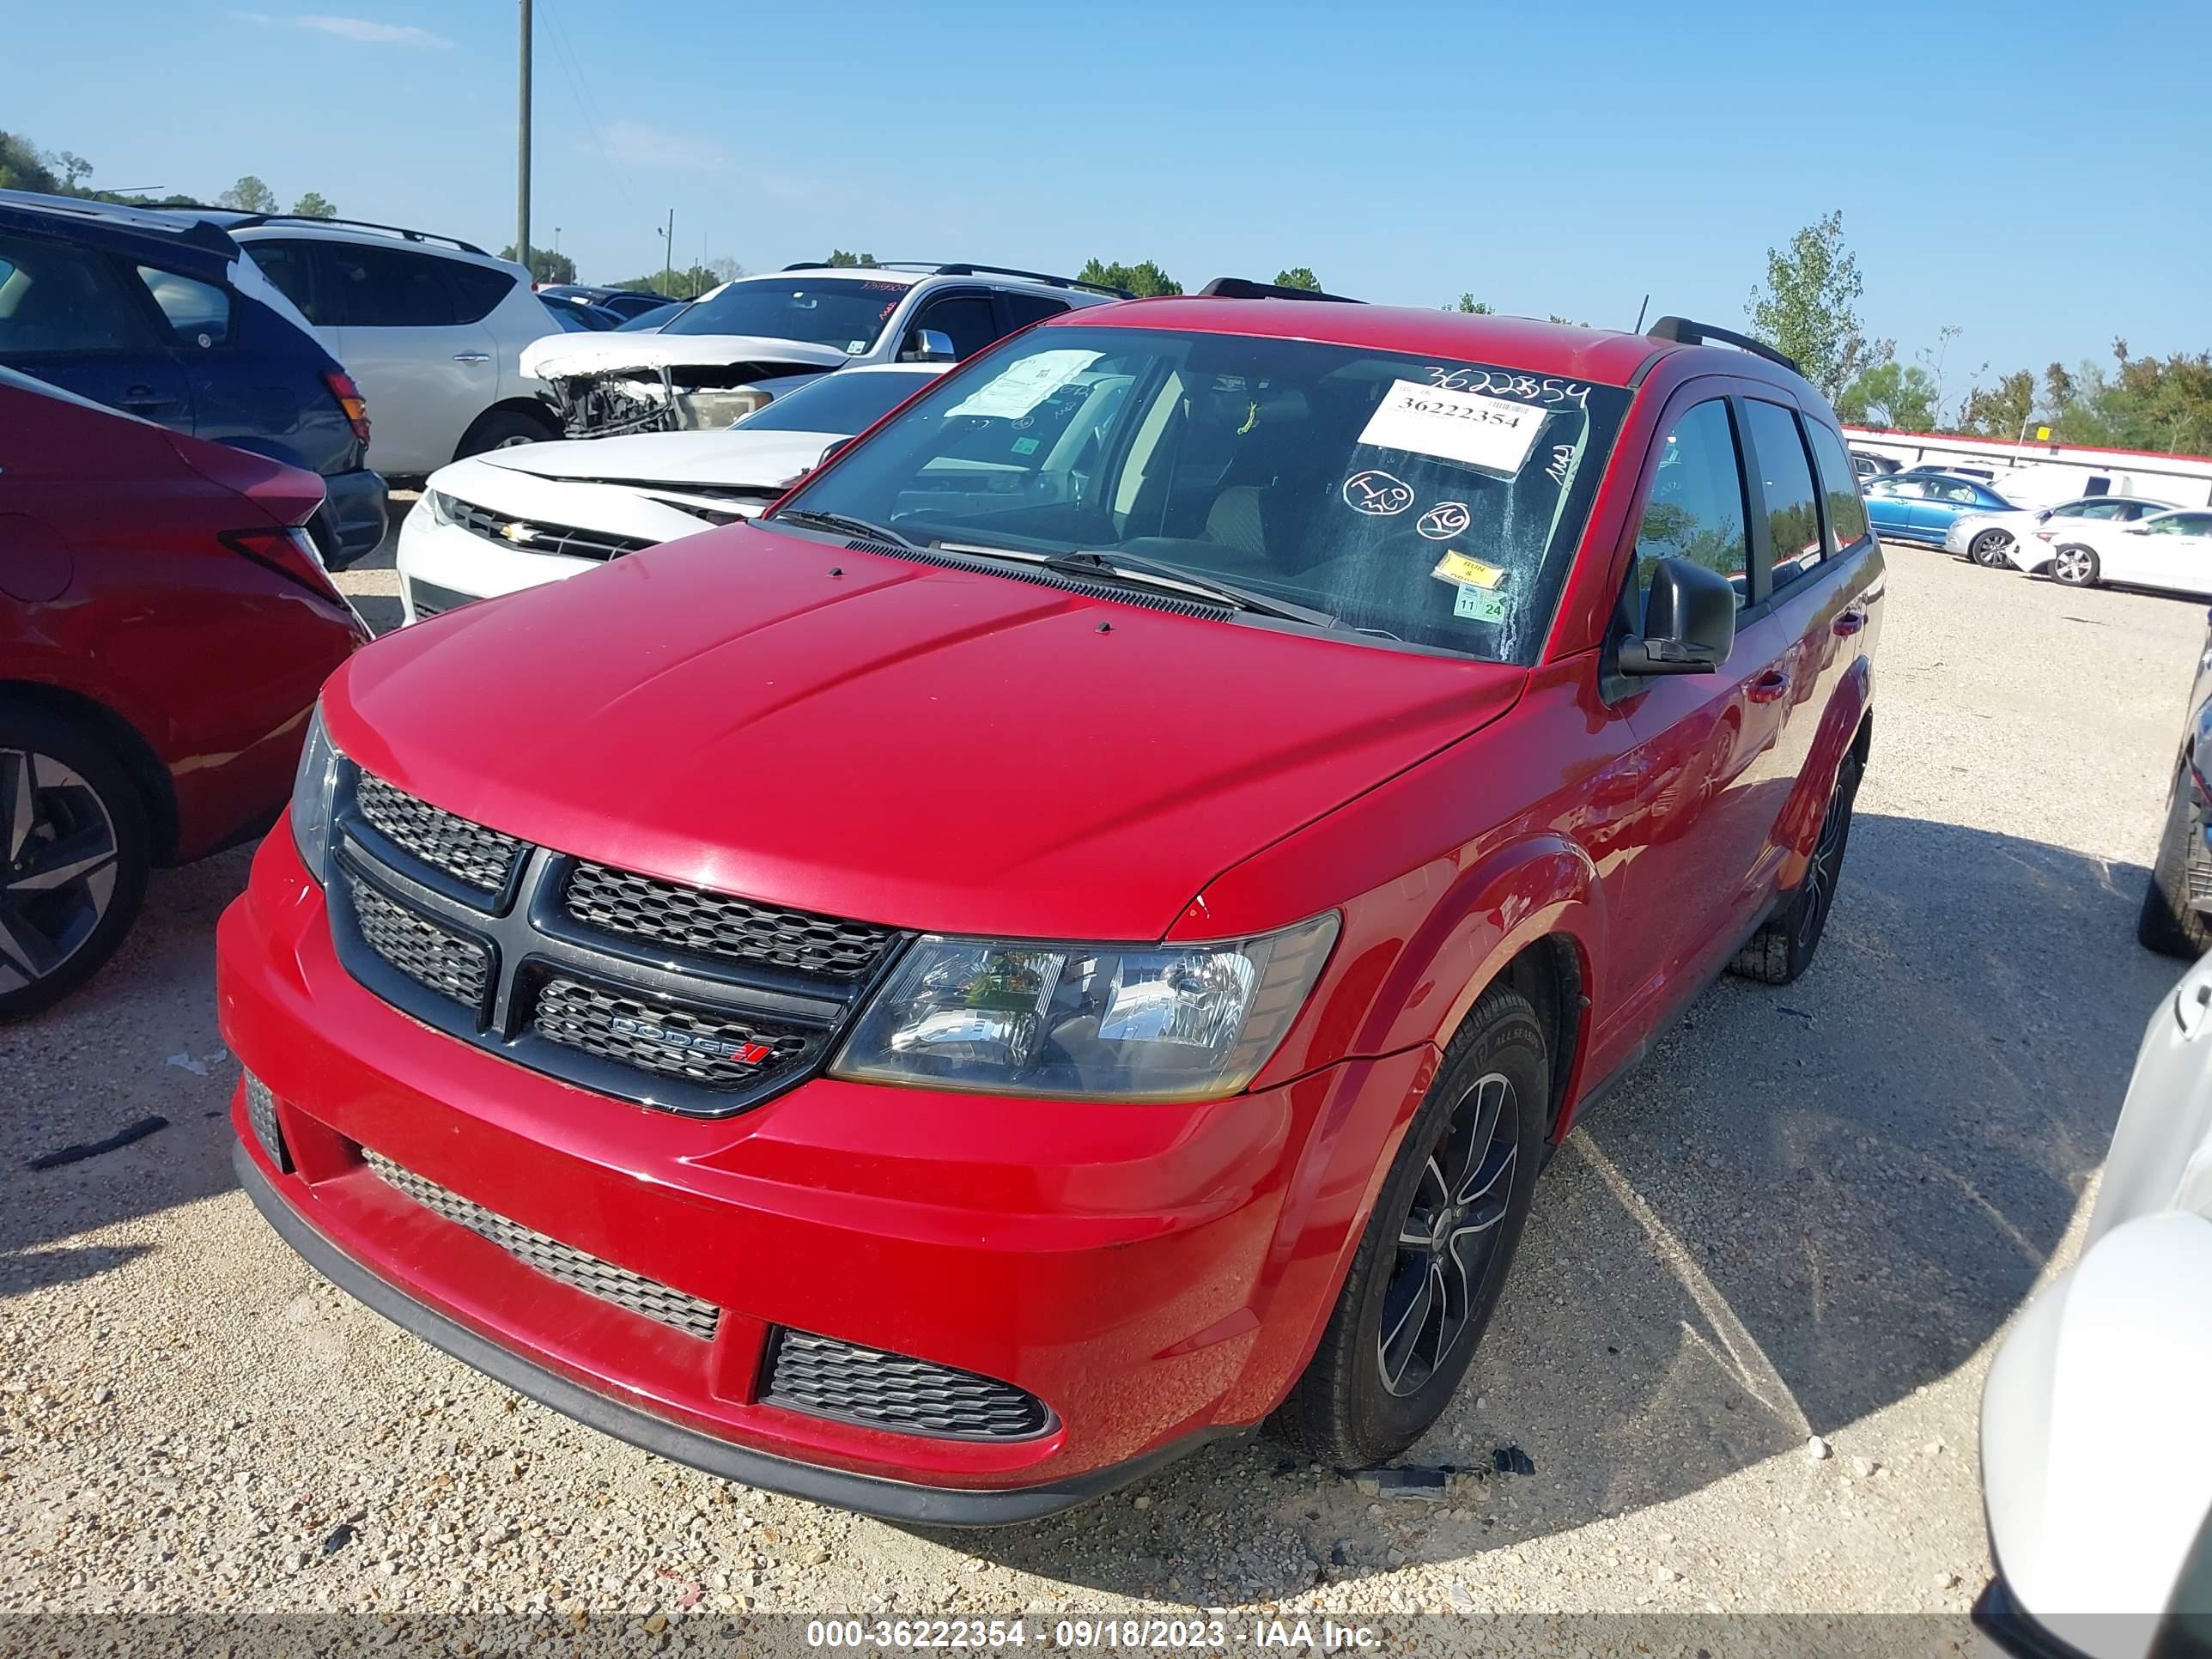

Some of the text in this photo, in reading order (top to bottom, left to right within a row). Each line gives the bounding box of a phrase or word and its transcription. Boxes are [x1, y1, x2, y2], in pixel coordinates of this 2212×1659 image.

[1397, 397, 1520, 428] 36222354
[1463, 561, 1486, 572] RUN
[1461, 599, 1474, 611] 11
[1485, 604, 1501, 616] 24
[611, 1017, 747, 1060] DODGE
[1496, 1030, 1511, 1045] ALL
